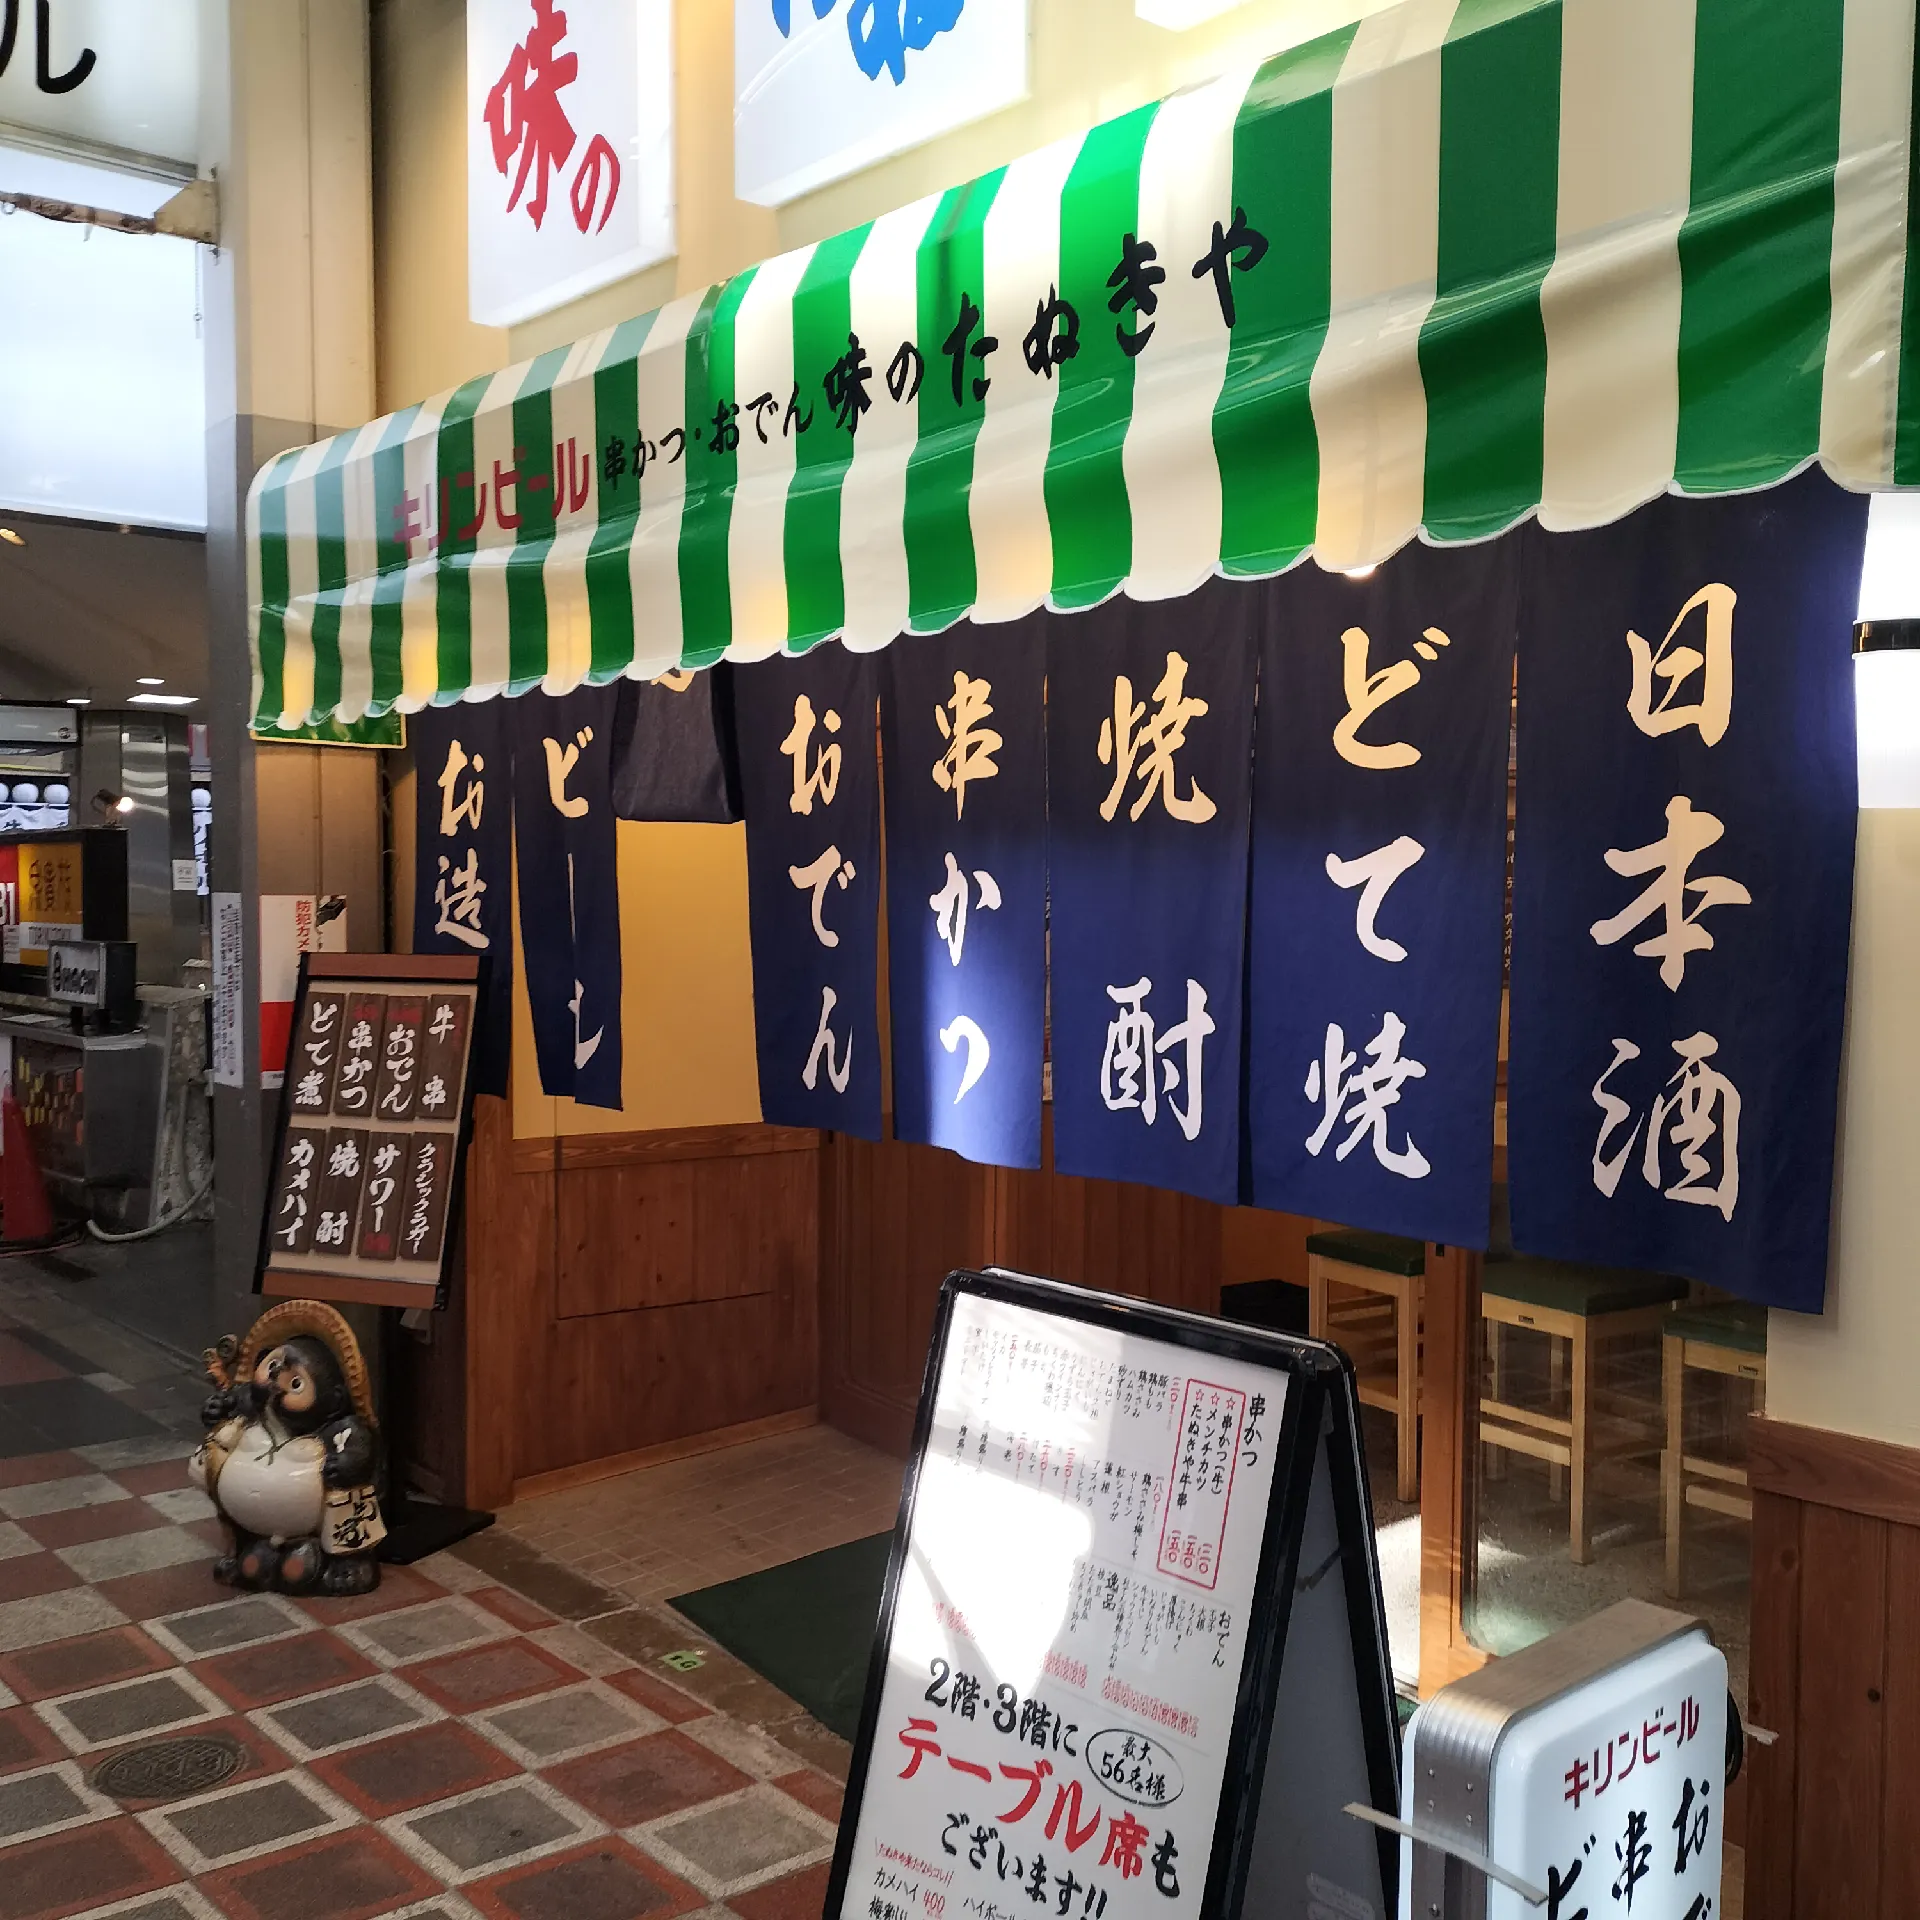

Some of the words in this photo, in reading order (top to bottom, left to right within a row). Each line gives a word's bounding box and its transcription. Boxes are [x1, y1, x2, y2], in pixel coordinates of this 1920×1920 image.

[483, 0, 621, 236] 味の
[393, 435, 590, 559] キリンビール
[823, 206, 1269, 438] 味のたぬきや
[778, 693, 857, 1094] おでん
[928, 670, 1003, 1105] 串かつ
[1096, 650, 1218, 1141] 焼酎
[1303, 626, 1451, 1179] どて焼
[1589, 582, 1753, 1222] 日本酒
[340, 1020, 373, 1109] 串かつ
[381, 1023, 416, 1113] おでん
[275, 1138, 315, 1246] カメハイ
[315, 1139, 360, 1246] 焼酎
[369, 1143, 402, 1233] サワー
[1197, 1408, 1218, 1492] メンチカツ
[1241, 1393, 1266, 1467] 串かつ
[1211, 1609, 1232, 1668] おでん
[1100, 1749, 1166, 1801] 56名様
[1564, 1695, 1700, 1809] キリンビール
[873, 1866, 919, 1904] カメハイ
[923, 1888, 946, 1914] 400
